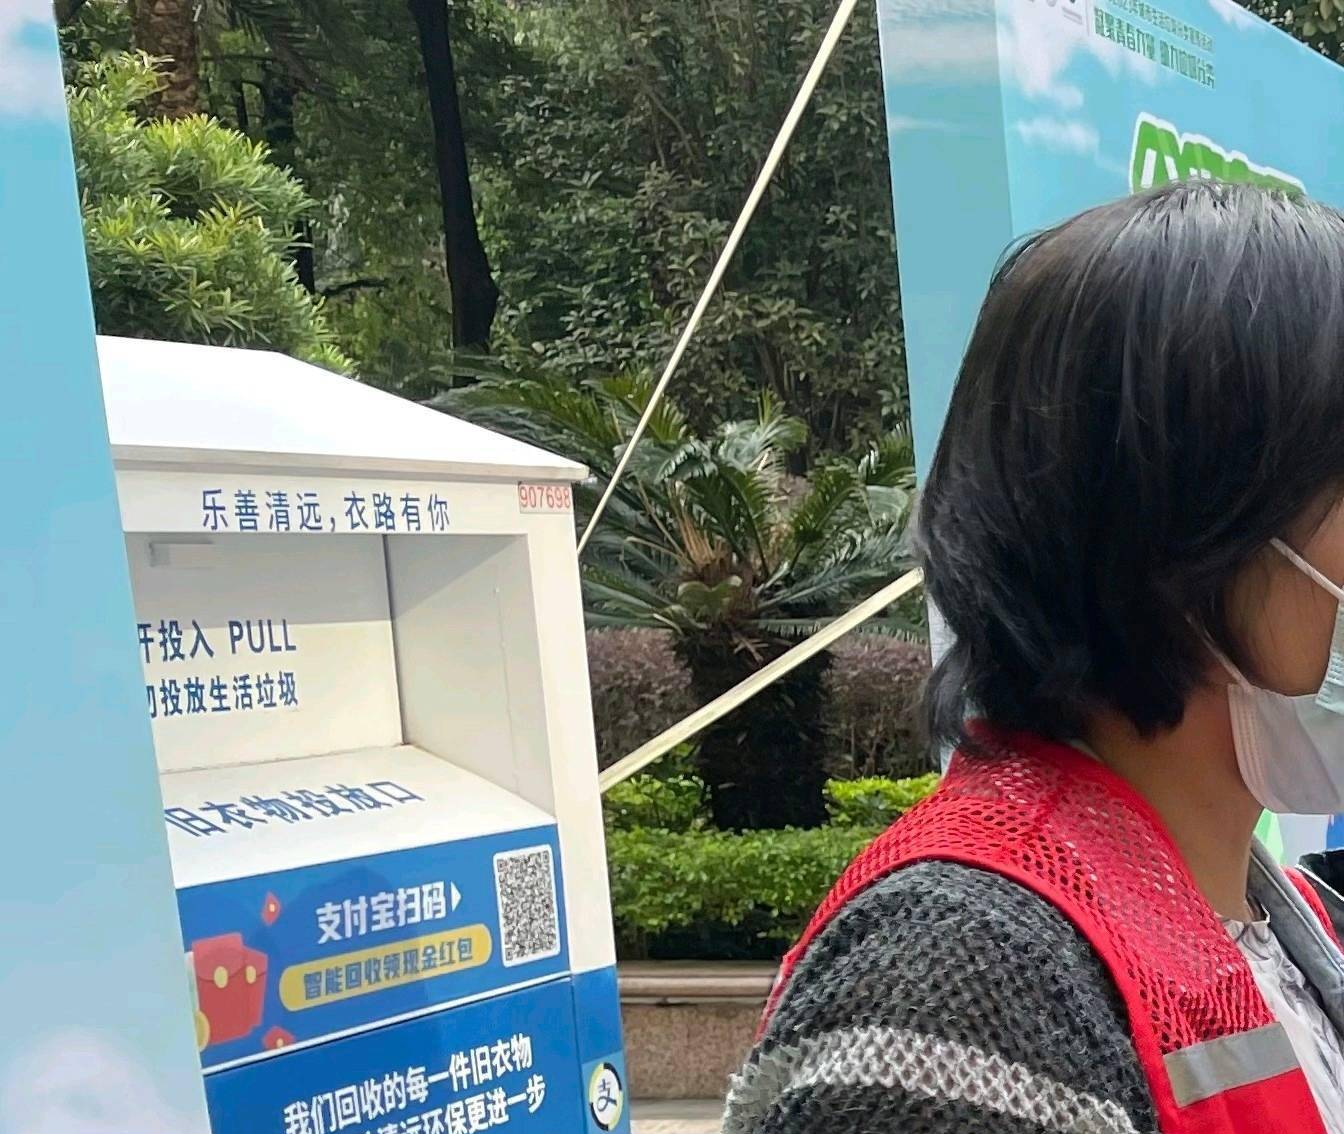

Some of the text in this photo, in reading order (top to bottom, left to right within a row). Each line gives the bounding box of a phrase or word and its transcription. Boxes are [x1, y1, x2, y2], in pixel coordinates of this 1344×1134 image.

[520, 486, 571, 508] 907698
[228, 618, 297, 654] PULL
[164, 781, 425, 837] 旧衣物投放口
[316, 881, 446, 944] 支付宝扫码
[302, 938, 473, 1000] 智能回收领现金红包
